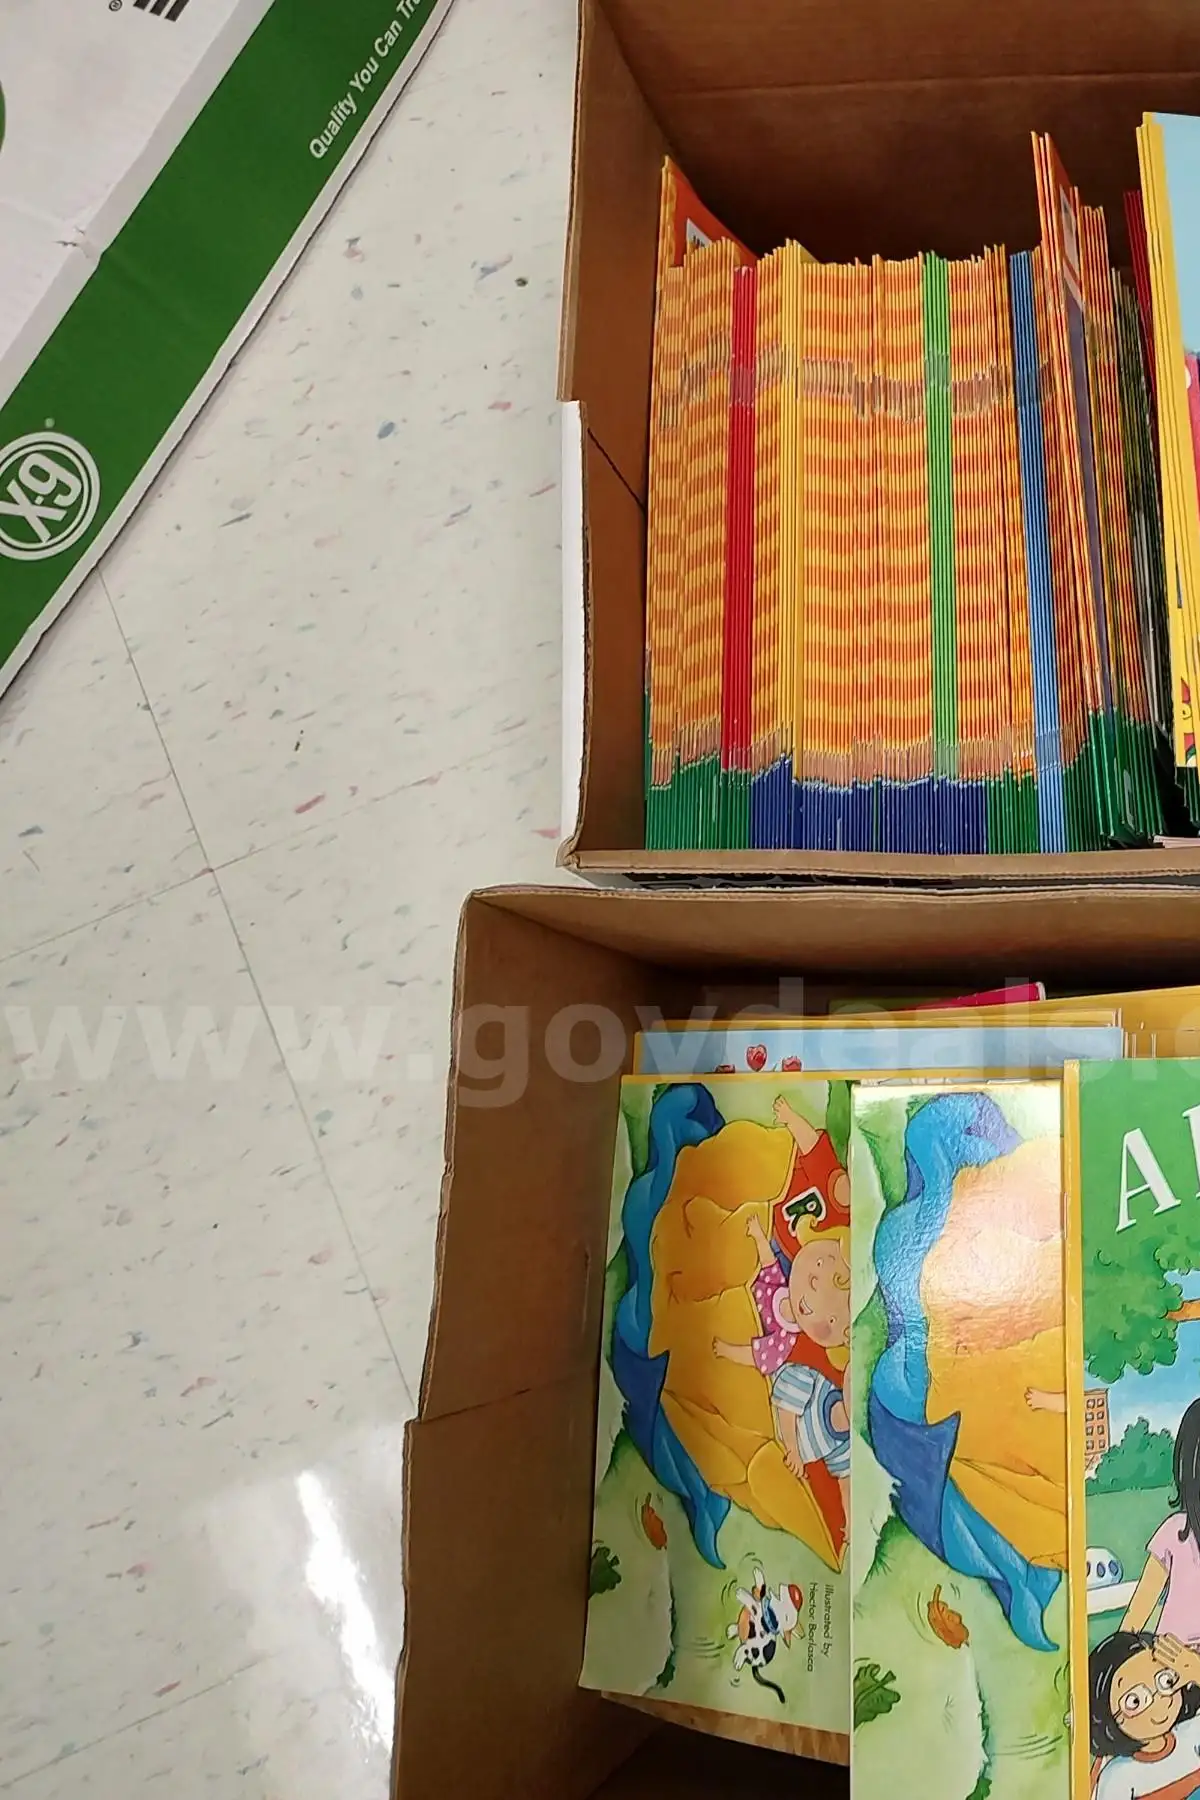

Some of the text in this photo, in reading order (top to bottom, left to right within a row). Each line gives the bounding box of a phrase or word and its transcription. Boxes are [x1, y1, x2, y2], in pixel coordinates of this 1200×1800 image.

[309, 92, 357, 159] Quality
[349, 57, 379, 93] You
[374, 20, 403, 57] Can
[1115, 1127, 1182, 1234] A
[821, 1584, 834, 1658] illustrated by
